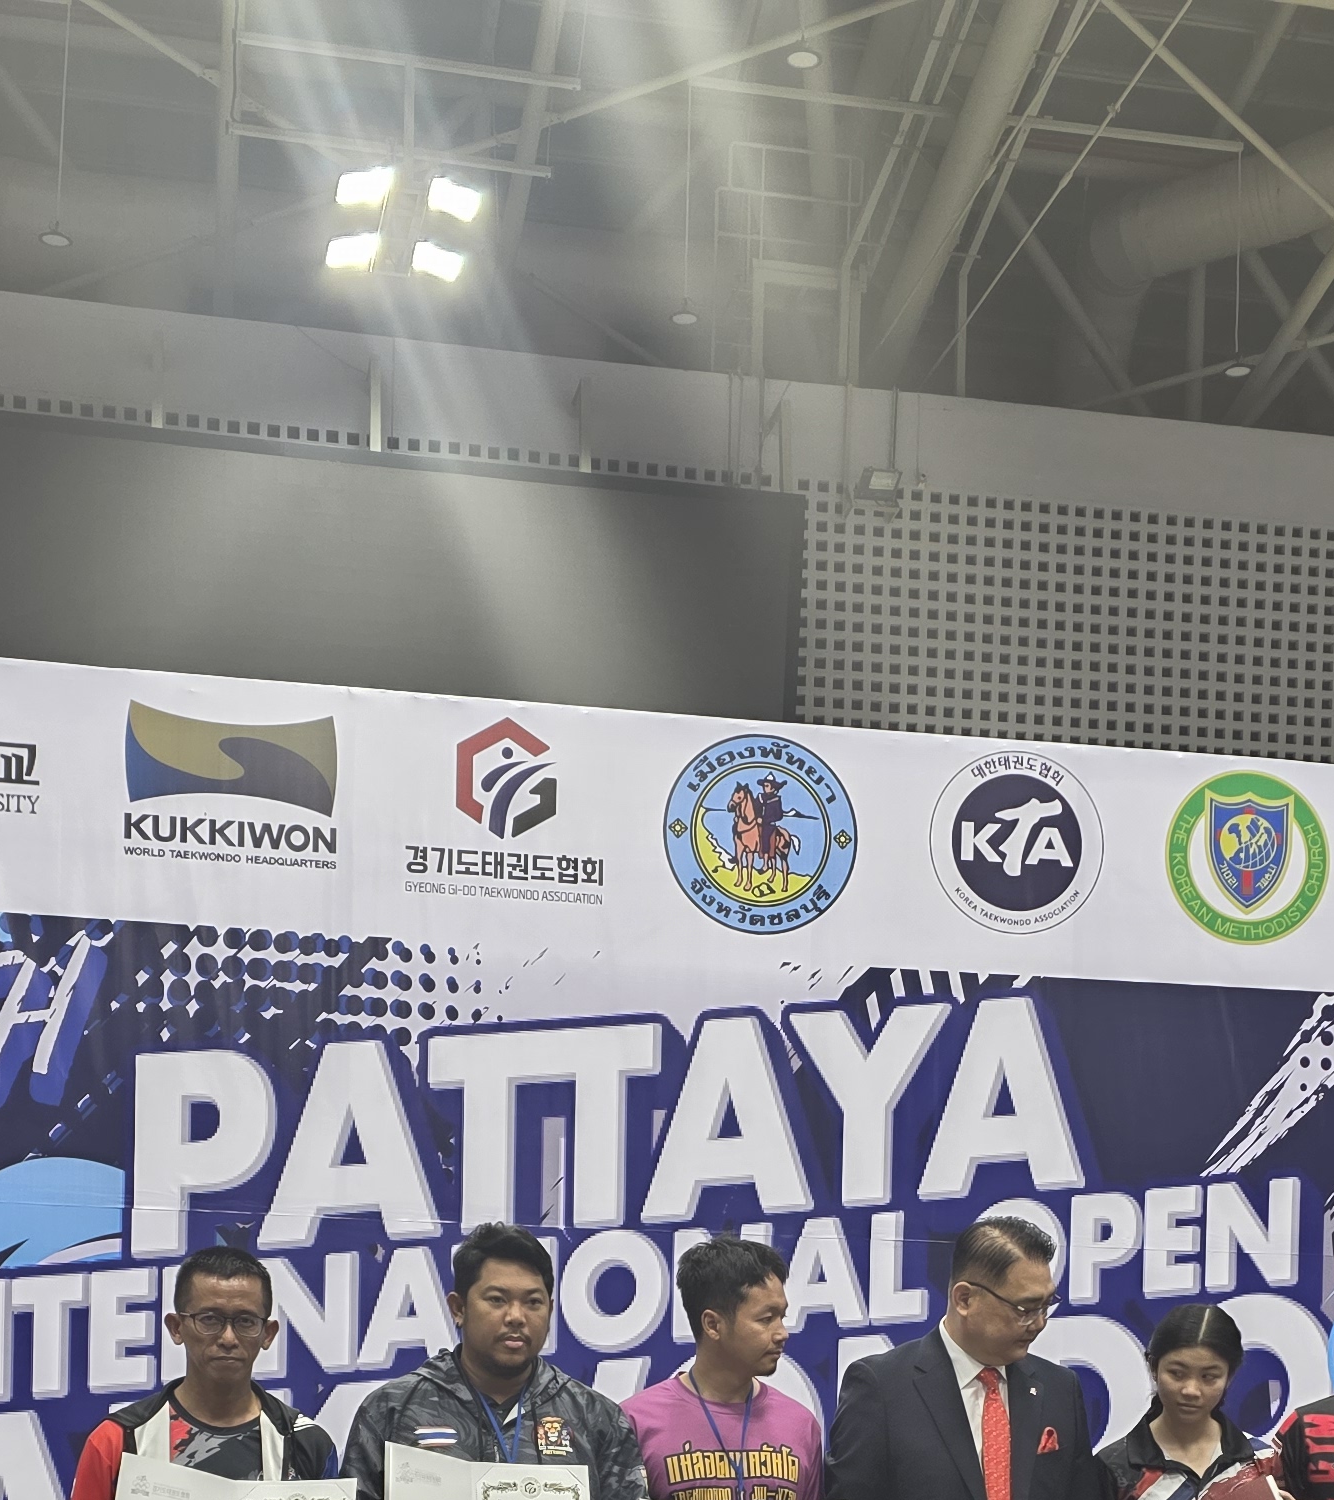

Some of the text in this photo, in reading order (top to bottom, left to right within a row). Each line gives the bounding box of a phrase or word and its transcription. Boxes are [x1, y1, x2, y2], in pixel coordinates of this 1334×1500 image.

[687, 742, 837, 804] เมืองพัทยา
[971, 755, 1065, 787] 대한태권도협회
[123, 812, 337, 854] KUKKIWON
[960, 797, 1074, 876] KTA
[123, 845, 337, 870] WORLD TAEKWONDO HEADQUARTERS
[405, 845, 604, 886] 경기도태권도협회
[1171, 814, 1324, 939] THE KOREAN METHODIST CHURCH
[405, 881, 603, 905] GYEONG GI-DO TAEKWONDO ASSOCIATION
[690, 877, 831, 926] จังหวัดชลบุรี
[954, 886, 1080, 927] KOREA TAEKWONDO ASSOCIATION
[131, 997, 1085, 1260] PATTAYA
